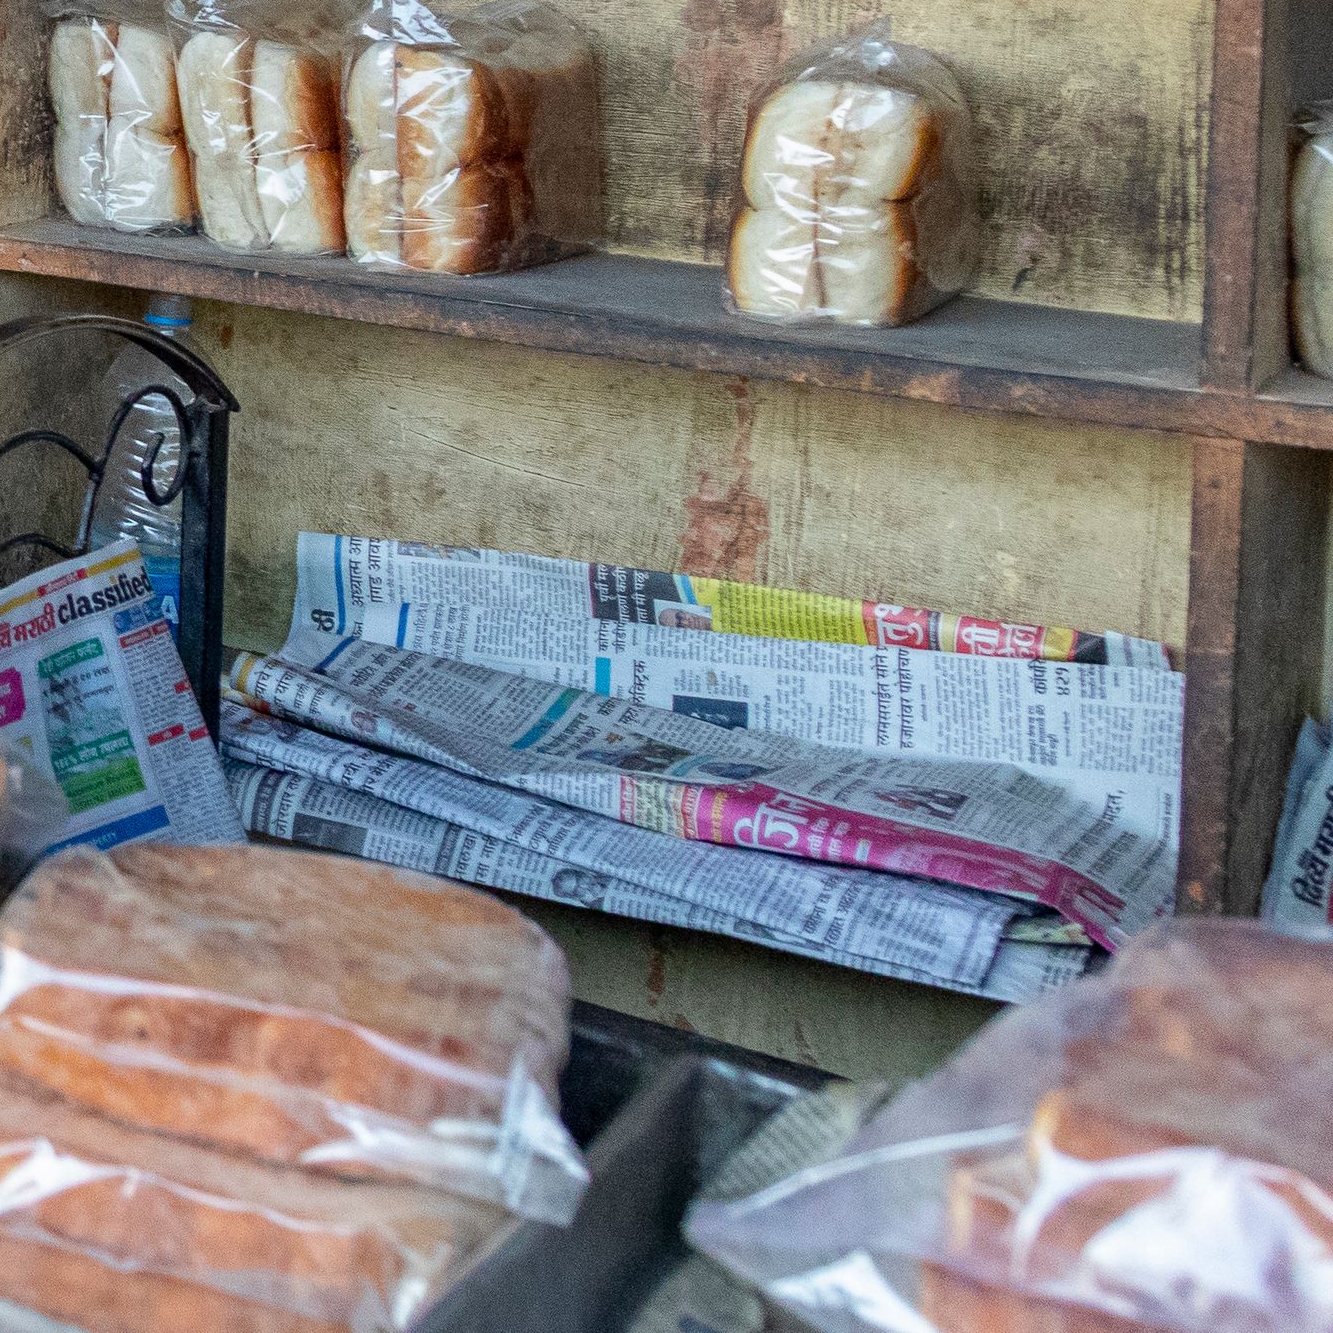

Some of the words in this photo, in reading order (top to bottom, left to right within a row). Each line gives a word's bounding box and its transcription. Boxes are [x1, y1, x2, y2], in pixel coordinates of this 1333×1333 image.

[12, 602, 57, 643] मराठी
[57, 566, 153, 626] classified
[349, 559, 365, 607] अध्यात्म
[870, 654, 890, 679] सोने
[871, 682, 892, 747] लग्नसराईत
[897, 697, 915, 750] हजारांवर
